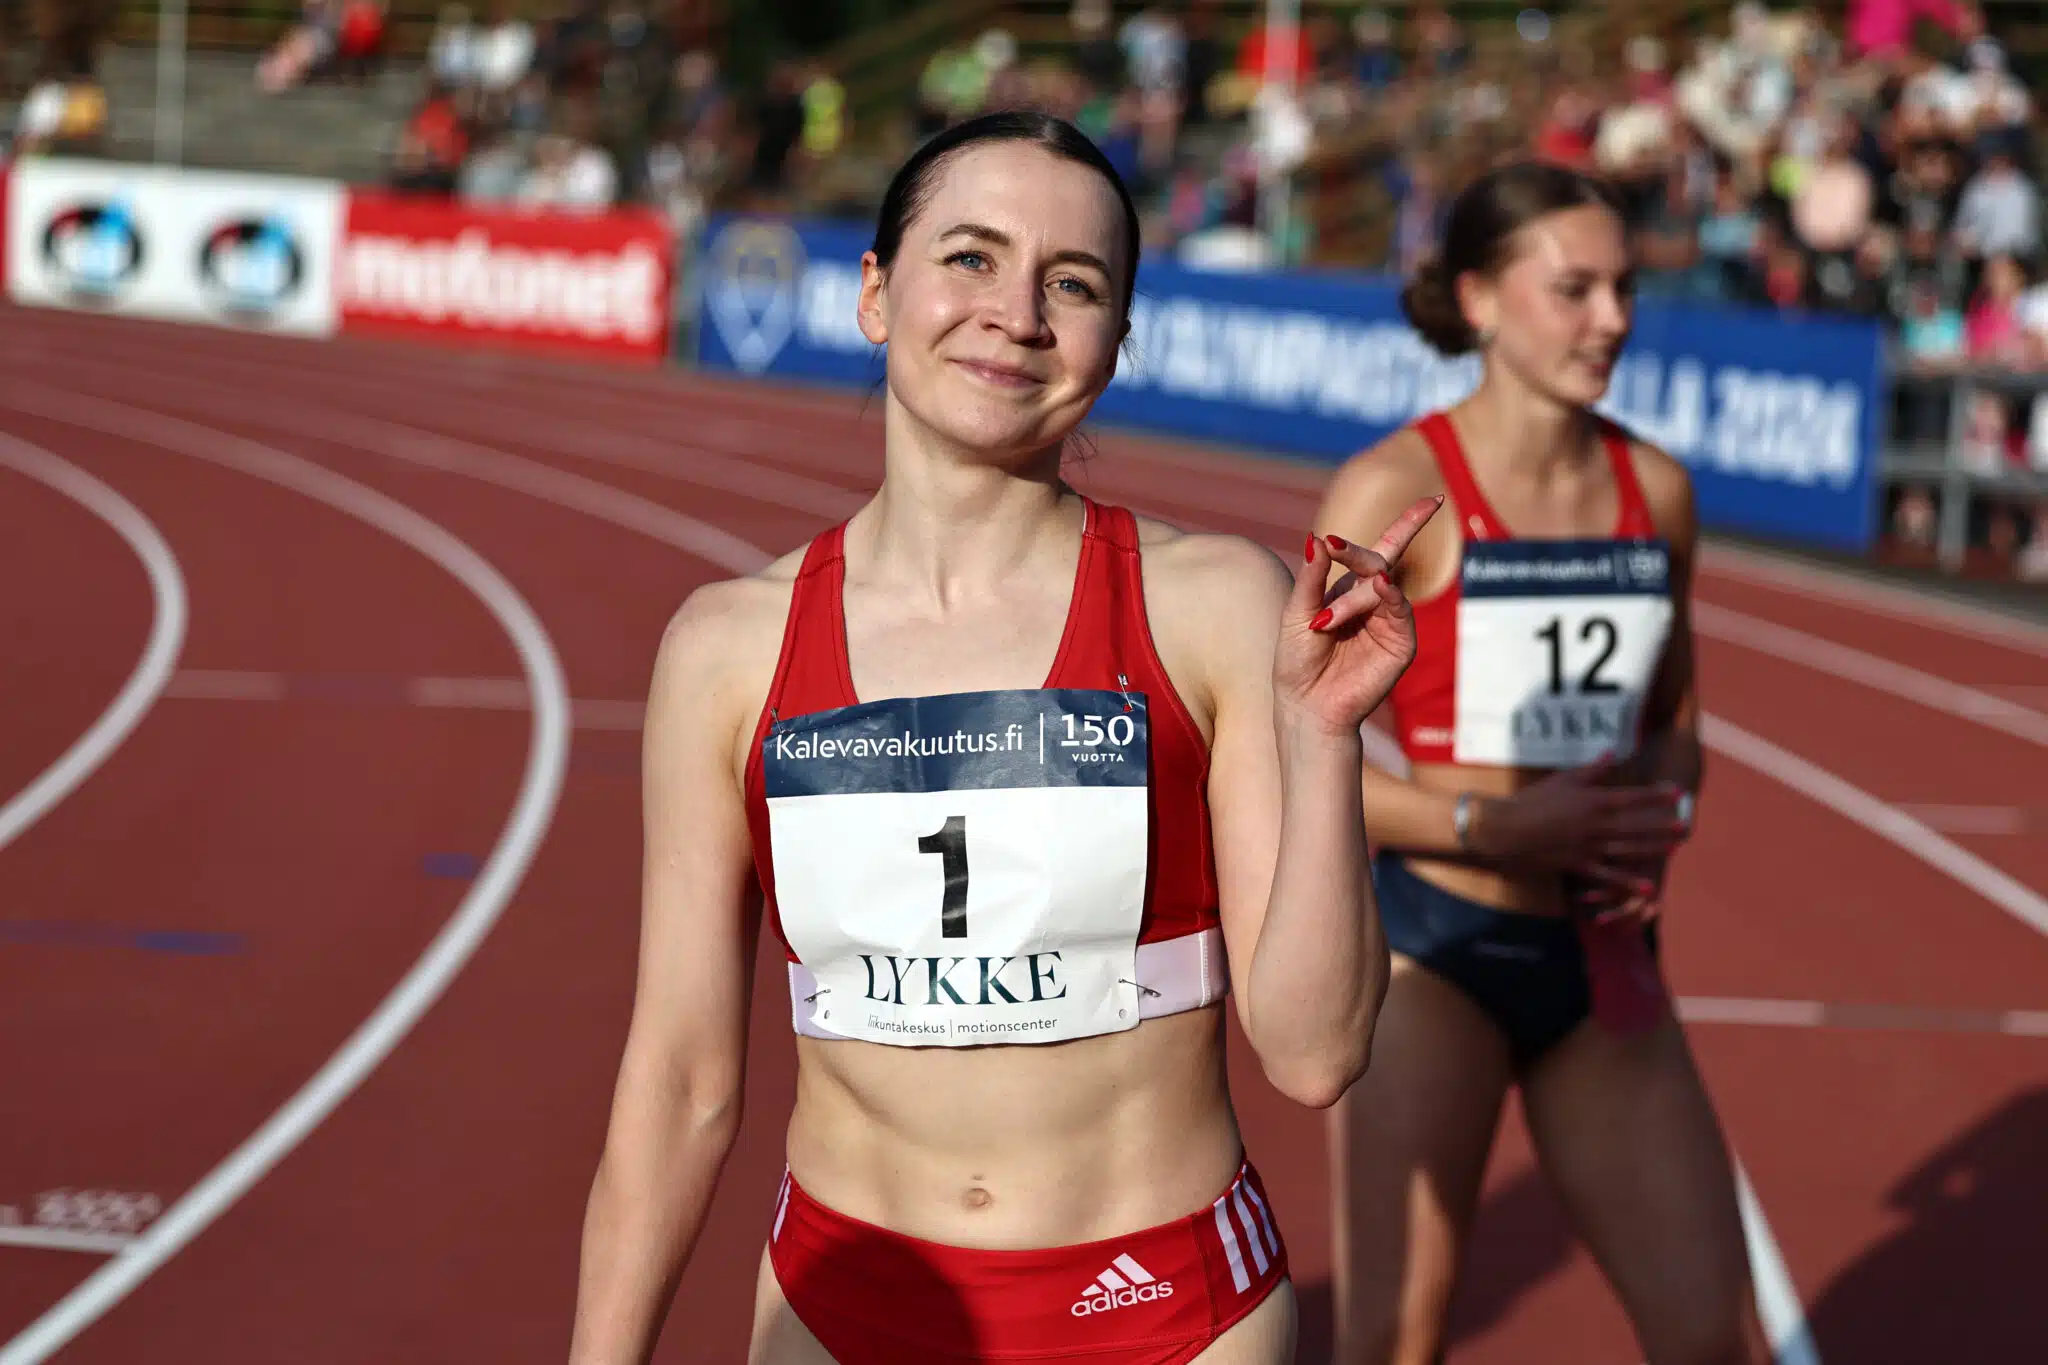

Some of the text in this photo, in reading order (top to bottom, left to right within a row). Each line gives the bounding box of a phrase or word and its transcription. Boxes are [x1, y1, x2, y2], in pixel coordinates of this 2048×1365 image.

[1534, 614, 1622, 696] 12
[775, 713, 1135, 761] Kalevavakuutus.fi 150
[1071, 753, 1125, 763] VUOTTA
[917, 814, 969, 939] 1
[857, 950, 1068, 1006] LYKKE
[867, 1013, 1058, 1035] liikuntakeskus motionscenter
[1070, 1281, 1174, 1317] adidas
